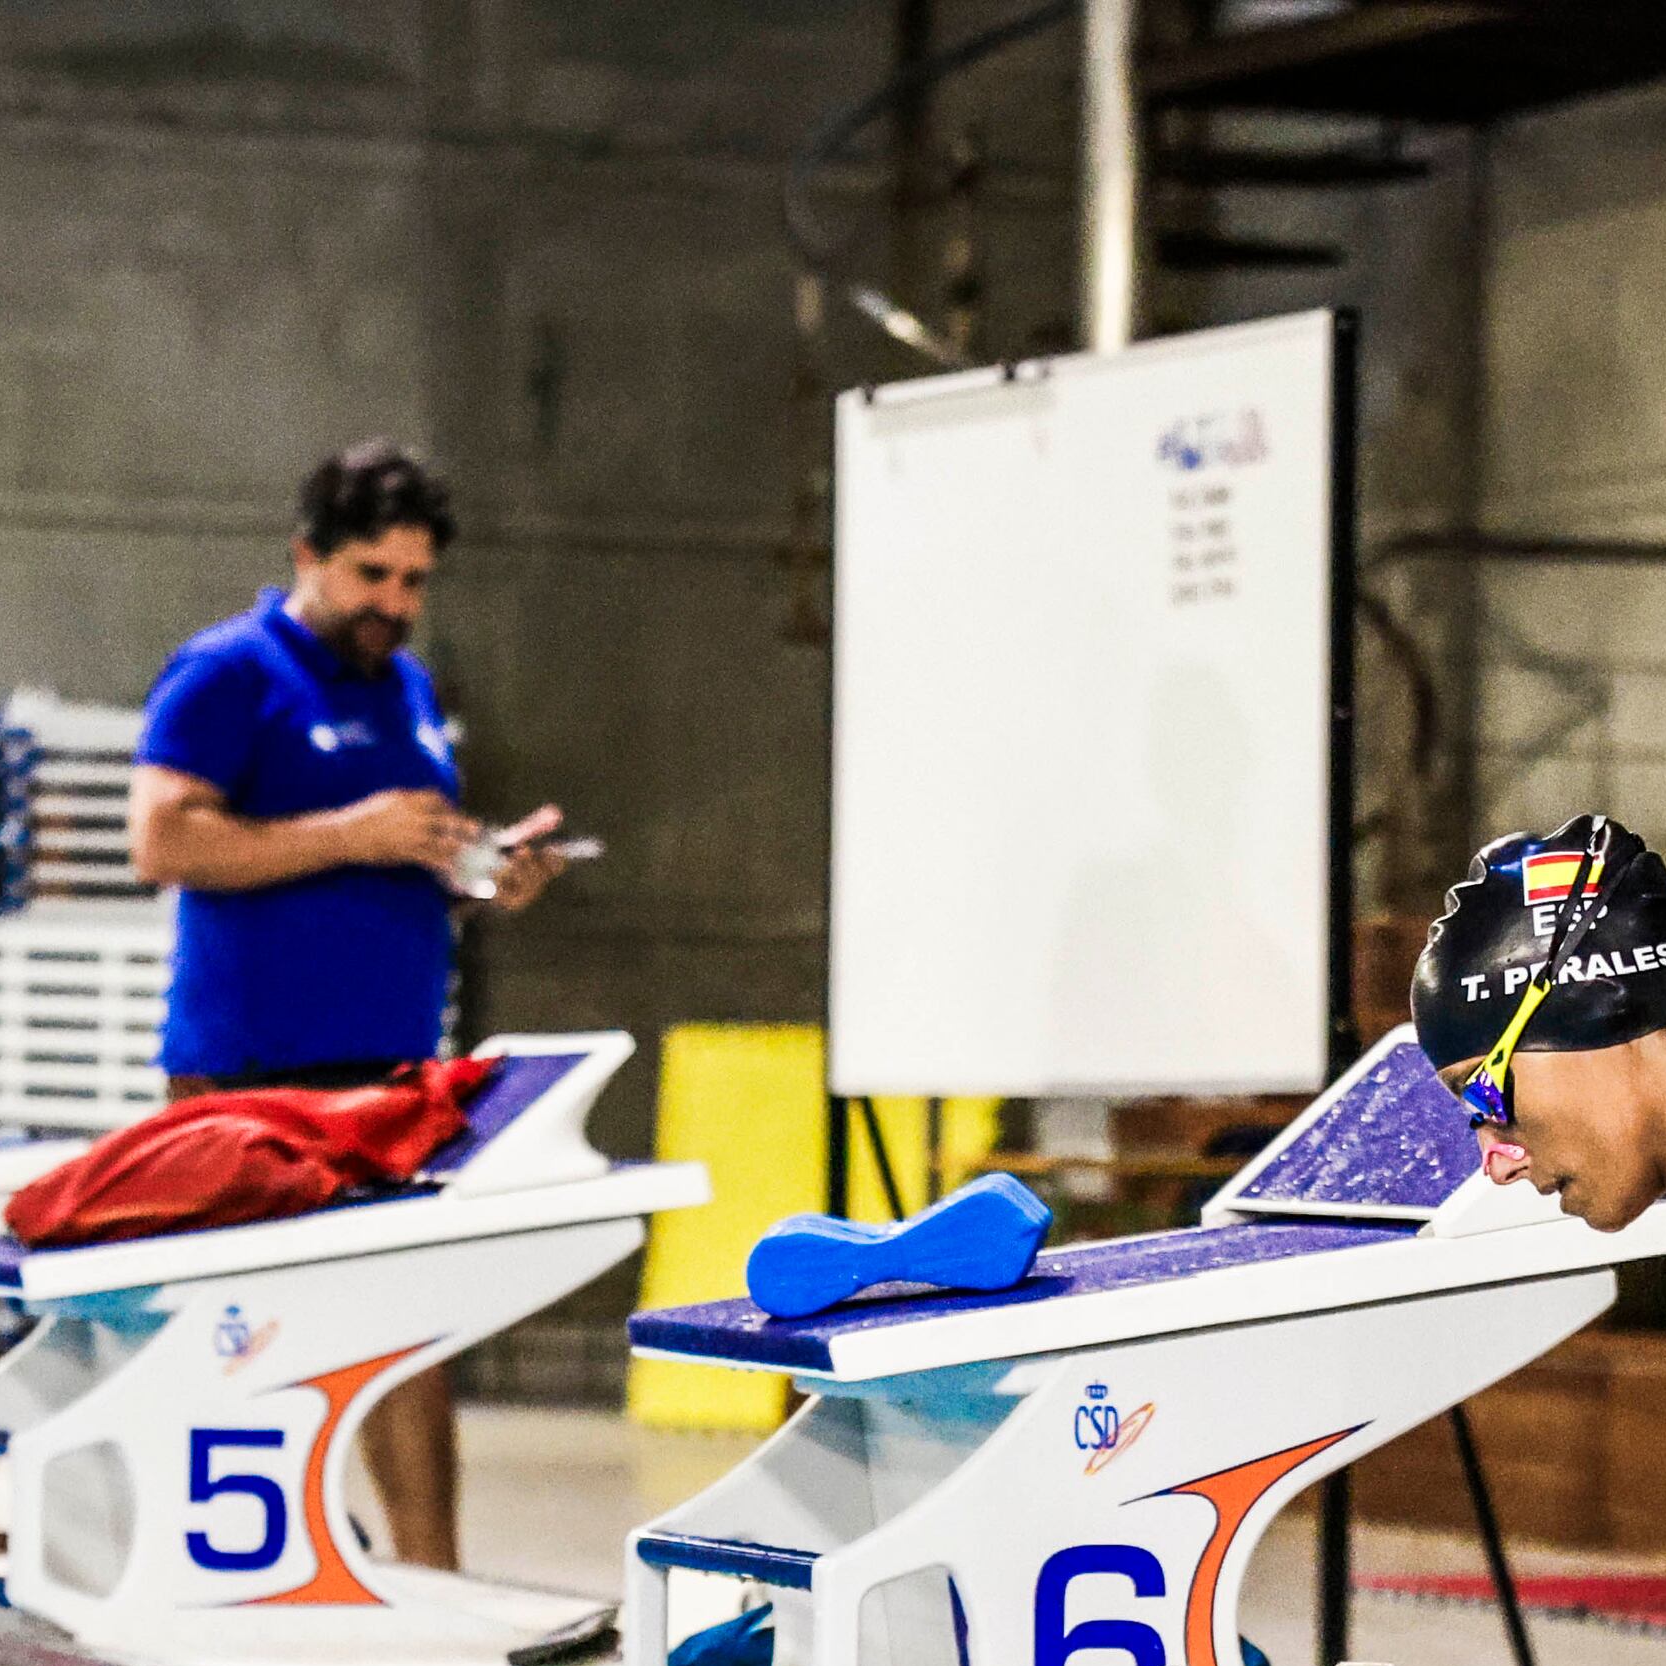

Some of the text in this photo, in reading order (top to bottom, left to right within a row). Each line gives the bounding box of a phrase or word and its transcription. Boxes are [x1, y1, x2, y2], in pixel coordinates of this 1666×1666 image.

[1460, 973, 1491, 1003] T.
[1073, 1404, 1120, 1451] CSD
[185, 1427, 289, 1573] 5
